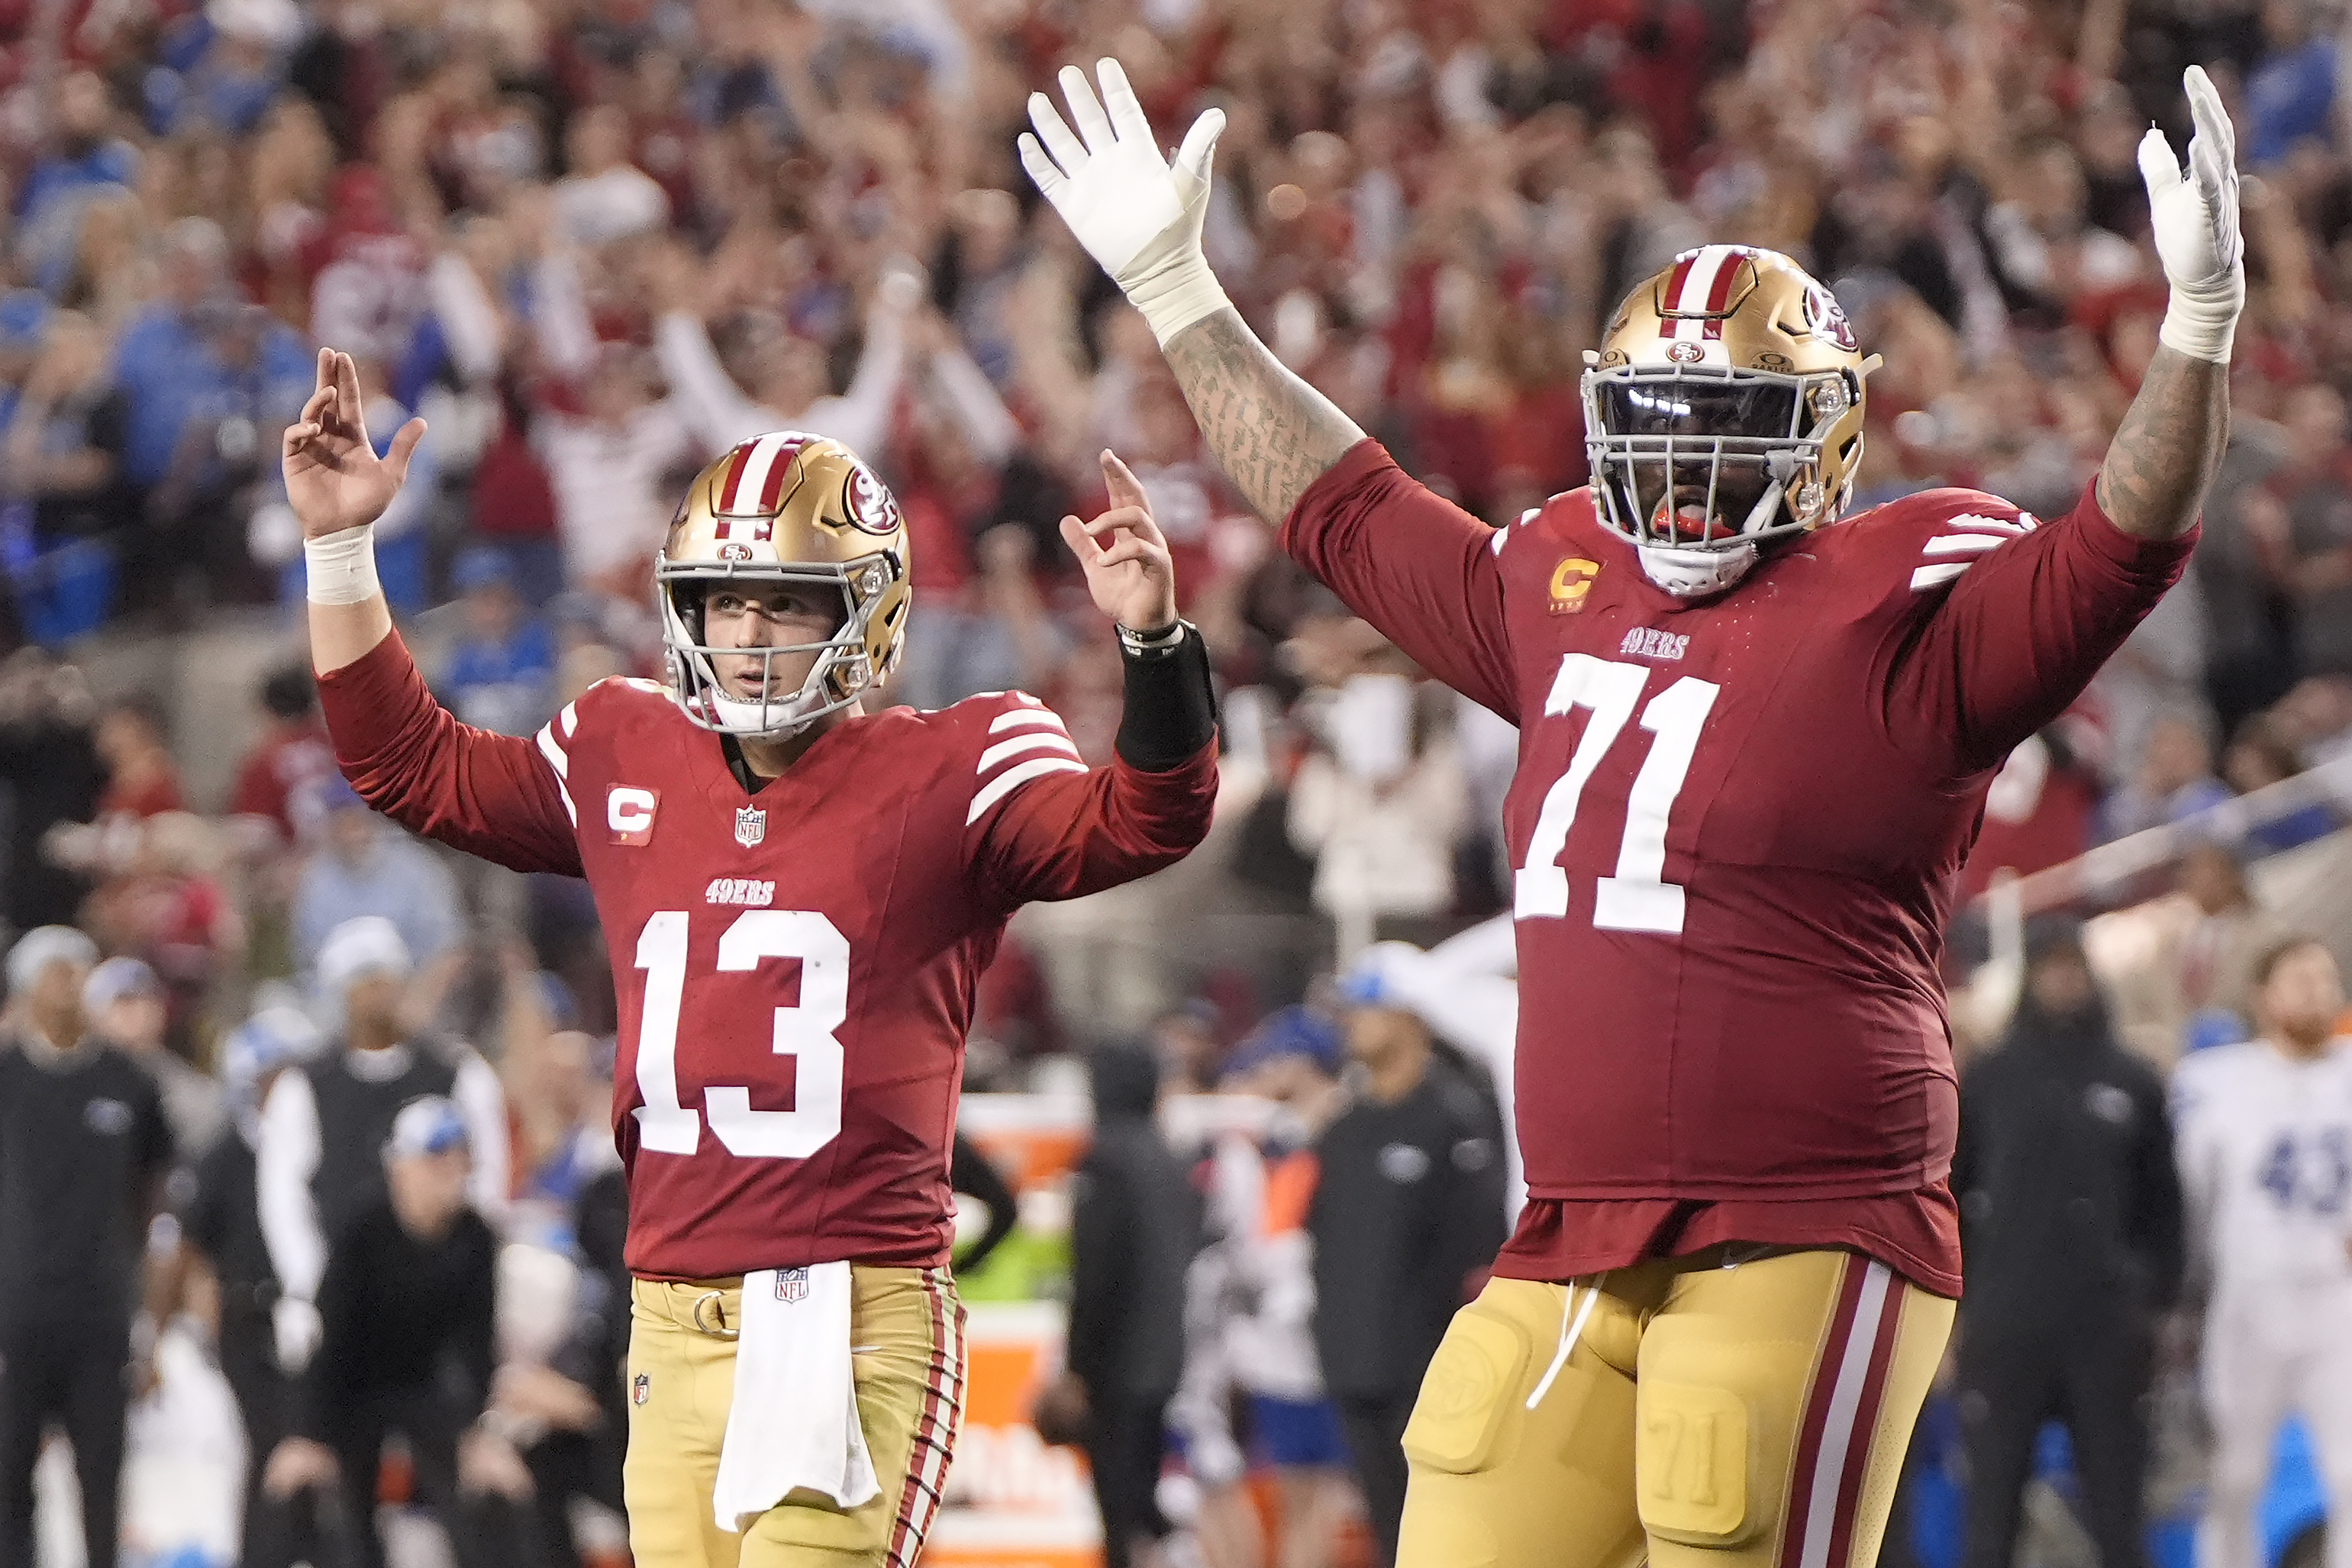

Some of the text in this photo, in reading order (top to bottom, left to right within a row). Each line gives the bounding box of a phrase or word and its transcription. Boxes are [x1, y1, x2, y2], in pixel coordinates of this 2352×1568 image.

[1675, 343, 1698, 360] SF
[1550, 558, 1600, 600] C
[1619, 626, 1691, 660] 49ERS
[608, 787, 655, 831] C
[1515, 653, 1721, 933] 71
[740, 824, 760, 839] NFL
[705, 878, 776, 906] 49ERS
[631, 909, 850, 1159] 13
[779, 1282, 805, 1299] NFL
[1647, 1408, 1721, 1507] 71
